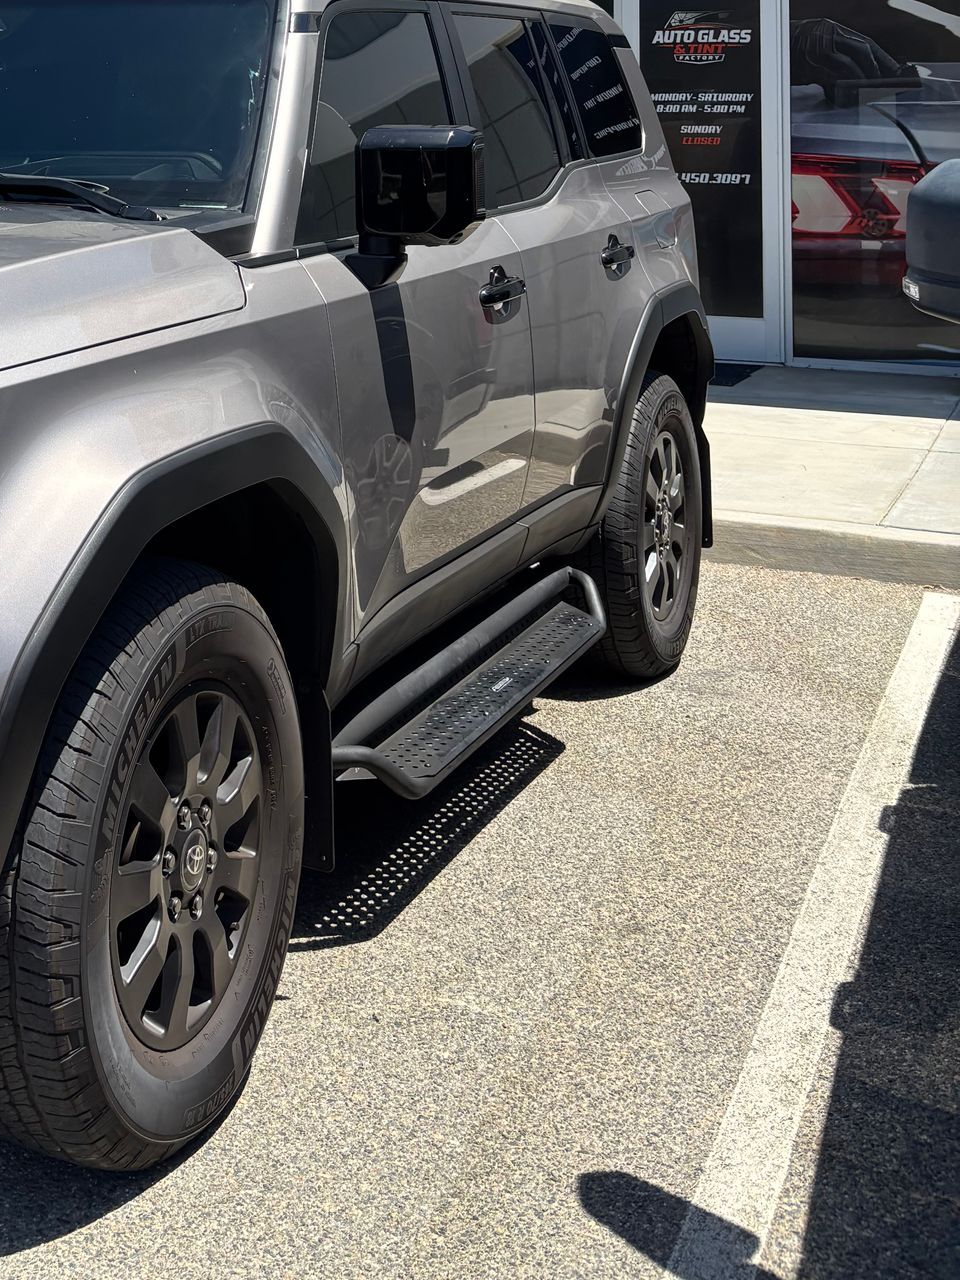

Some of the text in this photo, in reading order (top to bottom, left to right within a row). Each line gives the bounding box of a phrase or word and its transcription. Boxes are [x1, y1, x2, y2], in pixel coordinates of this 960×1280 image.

[652, 29, 752, 44] AUTO GLASS
[674, 45, 725, 54] & TINT
[656, 104, 680, 113] 8:00
[681, 104, 697, 113] AM
[704, 104, 728, 113] 5:00
[729, 105, 745, 113] PM
[680, 125, 722, 134] SUNDAY
[682, 137, 721, 145] CLOSED
[102, 654, 172, 842] MICHELIN
[242, 878, 296, 1060] MICHELIN
